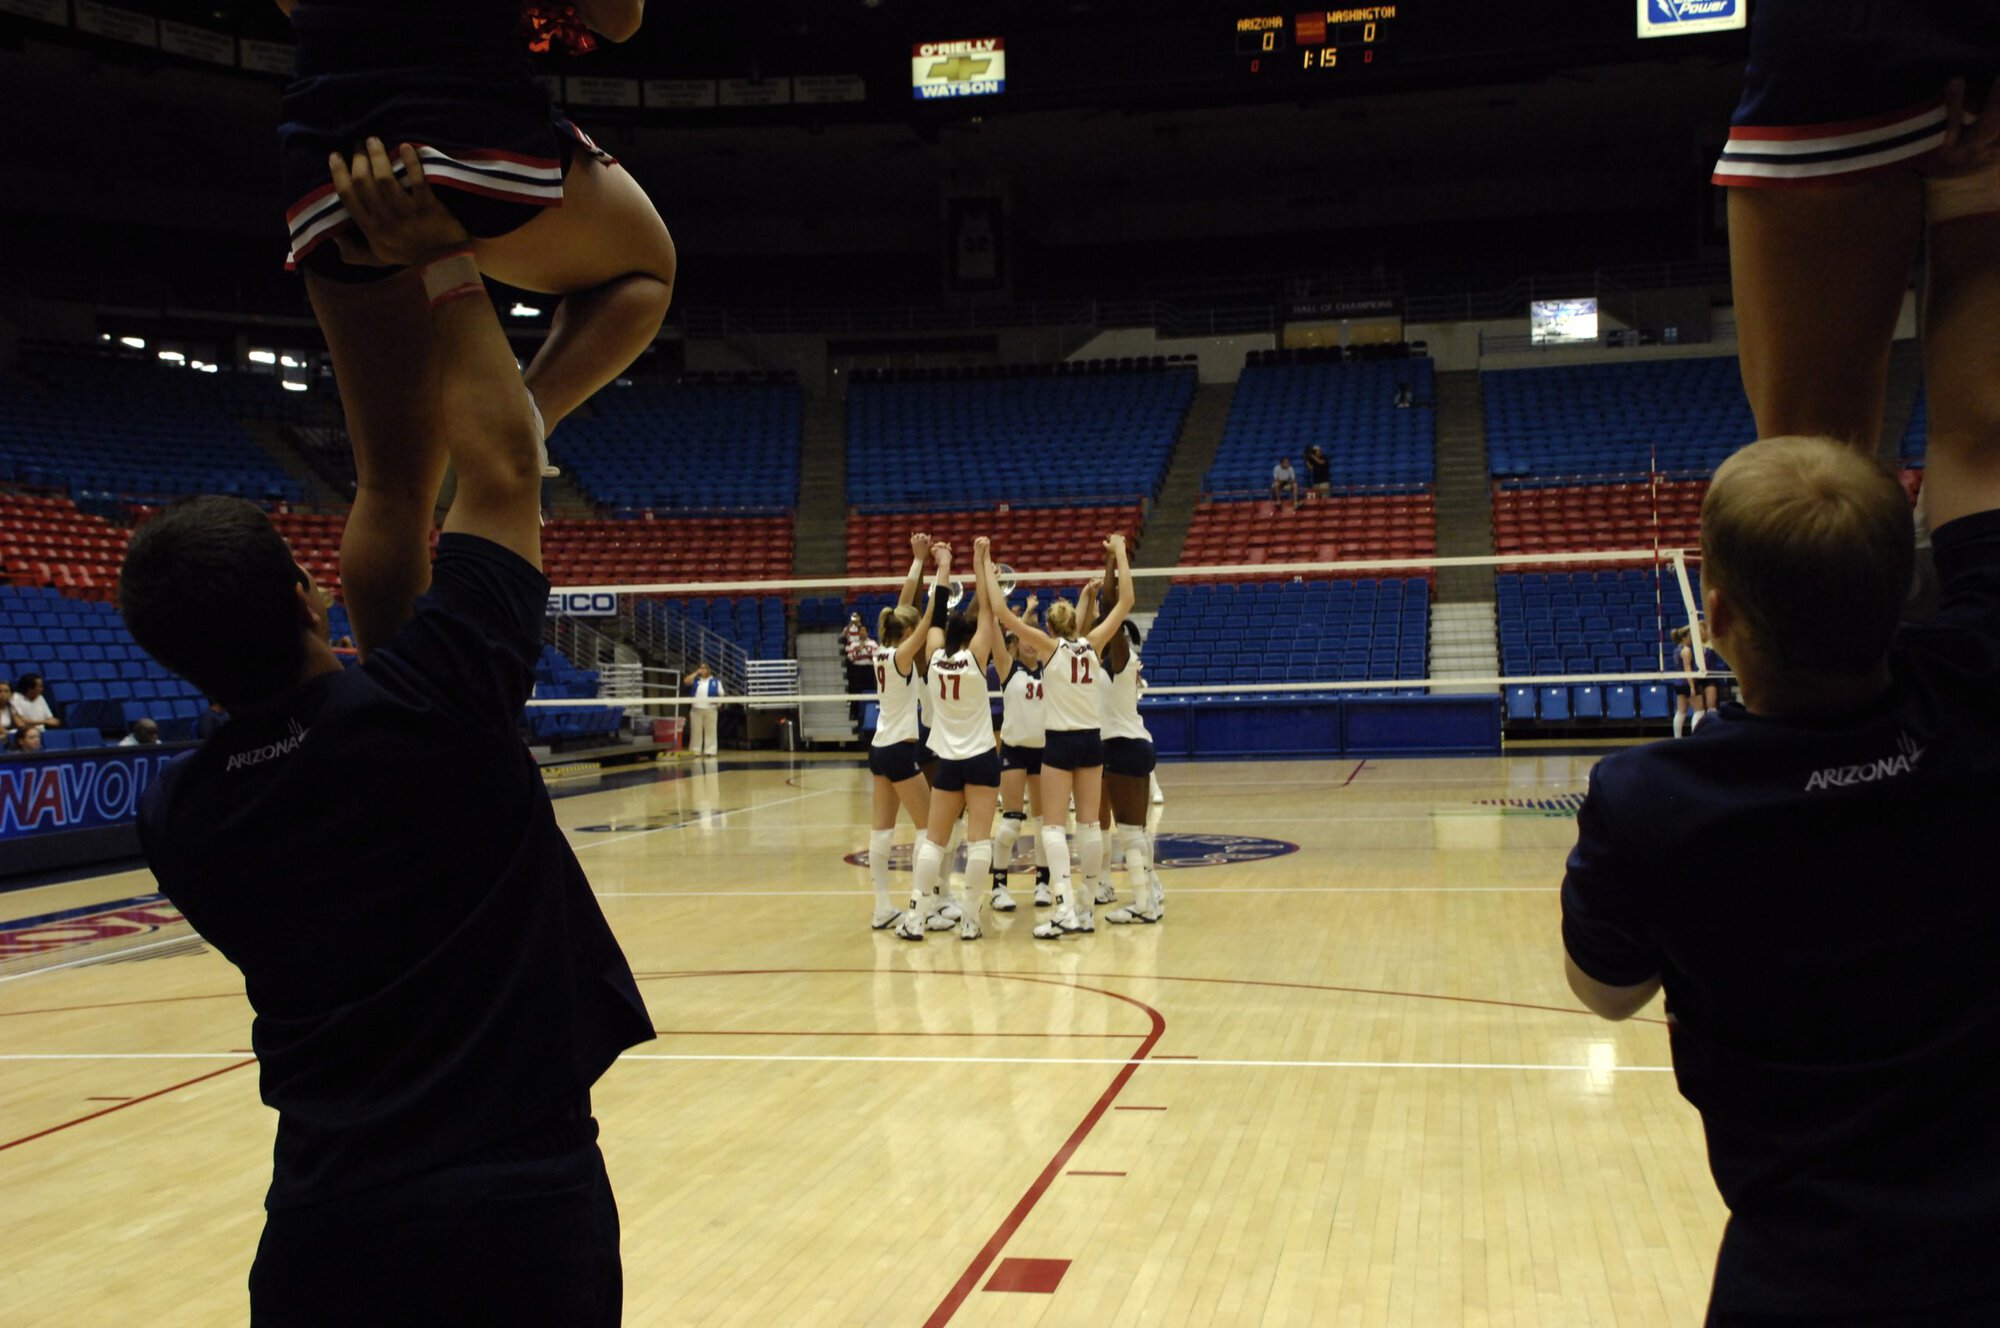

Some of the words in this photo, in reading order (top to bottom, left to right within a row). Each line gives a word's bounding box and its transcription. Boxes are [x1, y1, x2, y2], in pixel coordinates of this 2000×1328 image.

[1327, 6, 1396, 23] WASHINGTON
[1678, 0, 1728, 15] Power
[1237, 16, 1283, 31] ARIZONA
[1363, 22, 1376, 42] 0
[920, 39, 996, 57] O'RIELLY
[1262, 31, 1275, 51] 0
[921, 81, 998, 98] WATSON
[1071, 656, 1093, 684] 12
[938, 674, 961, 700] 17
[1025, 682, 1044, 700] 34
[226, 735, 300, 772] ARIZONA
[1804, 754, 1912, 792] ARIZONA
